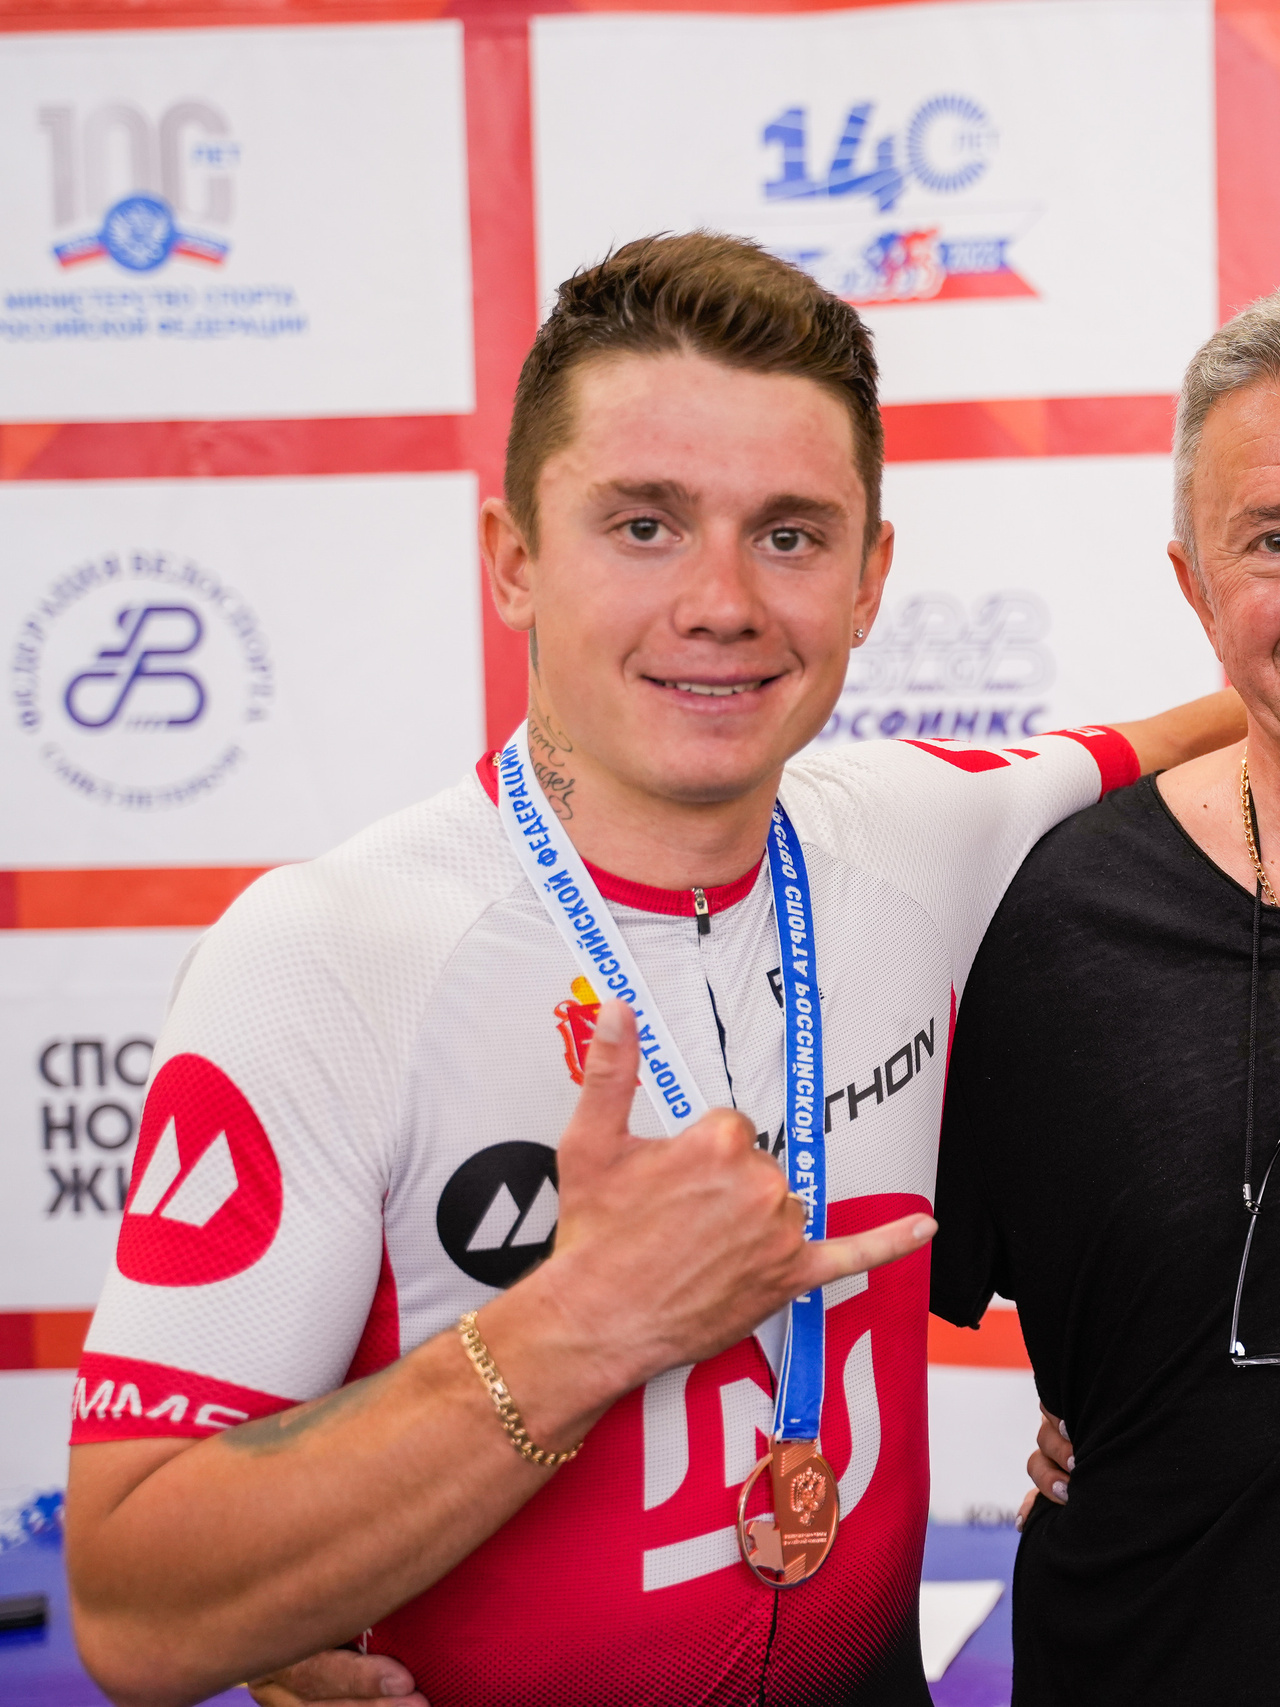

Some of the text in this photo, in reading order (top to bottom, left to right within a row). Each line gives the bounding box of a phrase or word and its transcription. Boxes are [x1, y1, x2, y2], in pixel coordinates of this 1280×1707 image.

[820, 706, 1047, 739] ОСФИНКС
[40, 1040, 155, 1088] СПО
[638, 1024, 692, 1120] СПОРТА
